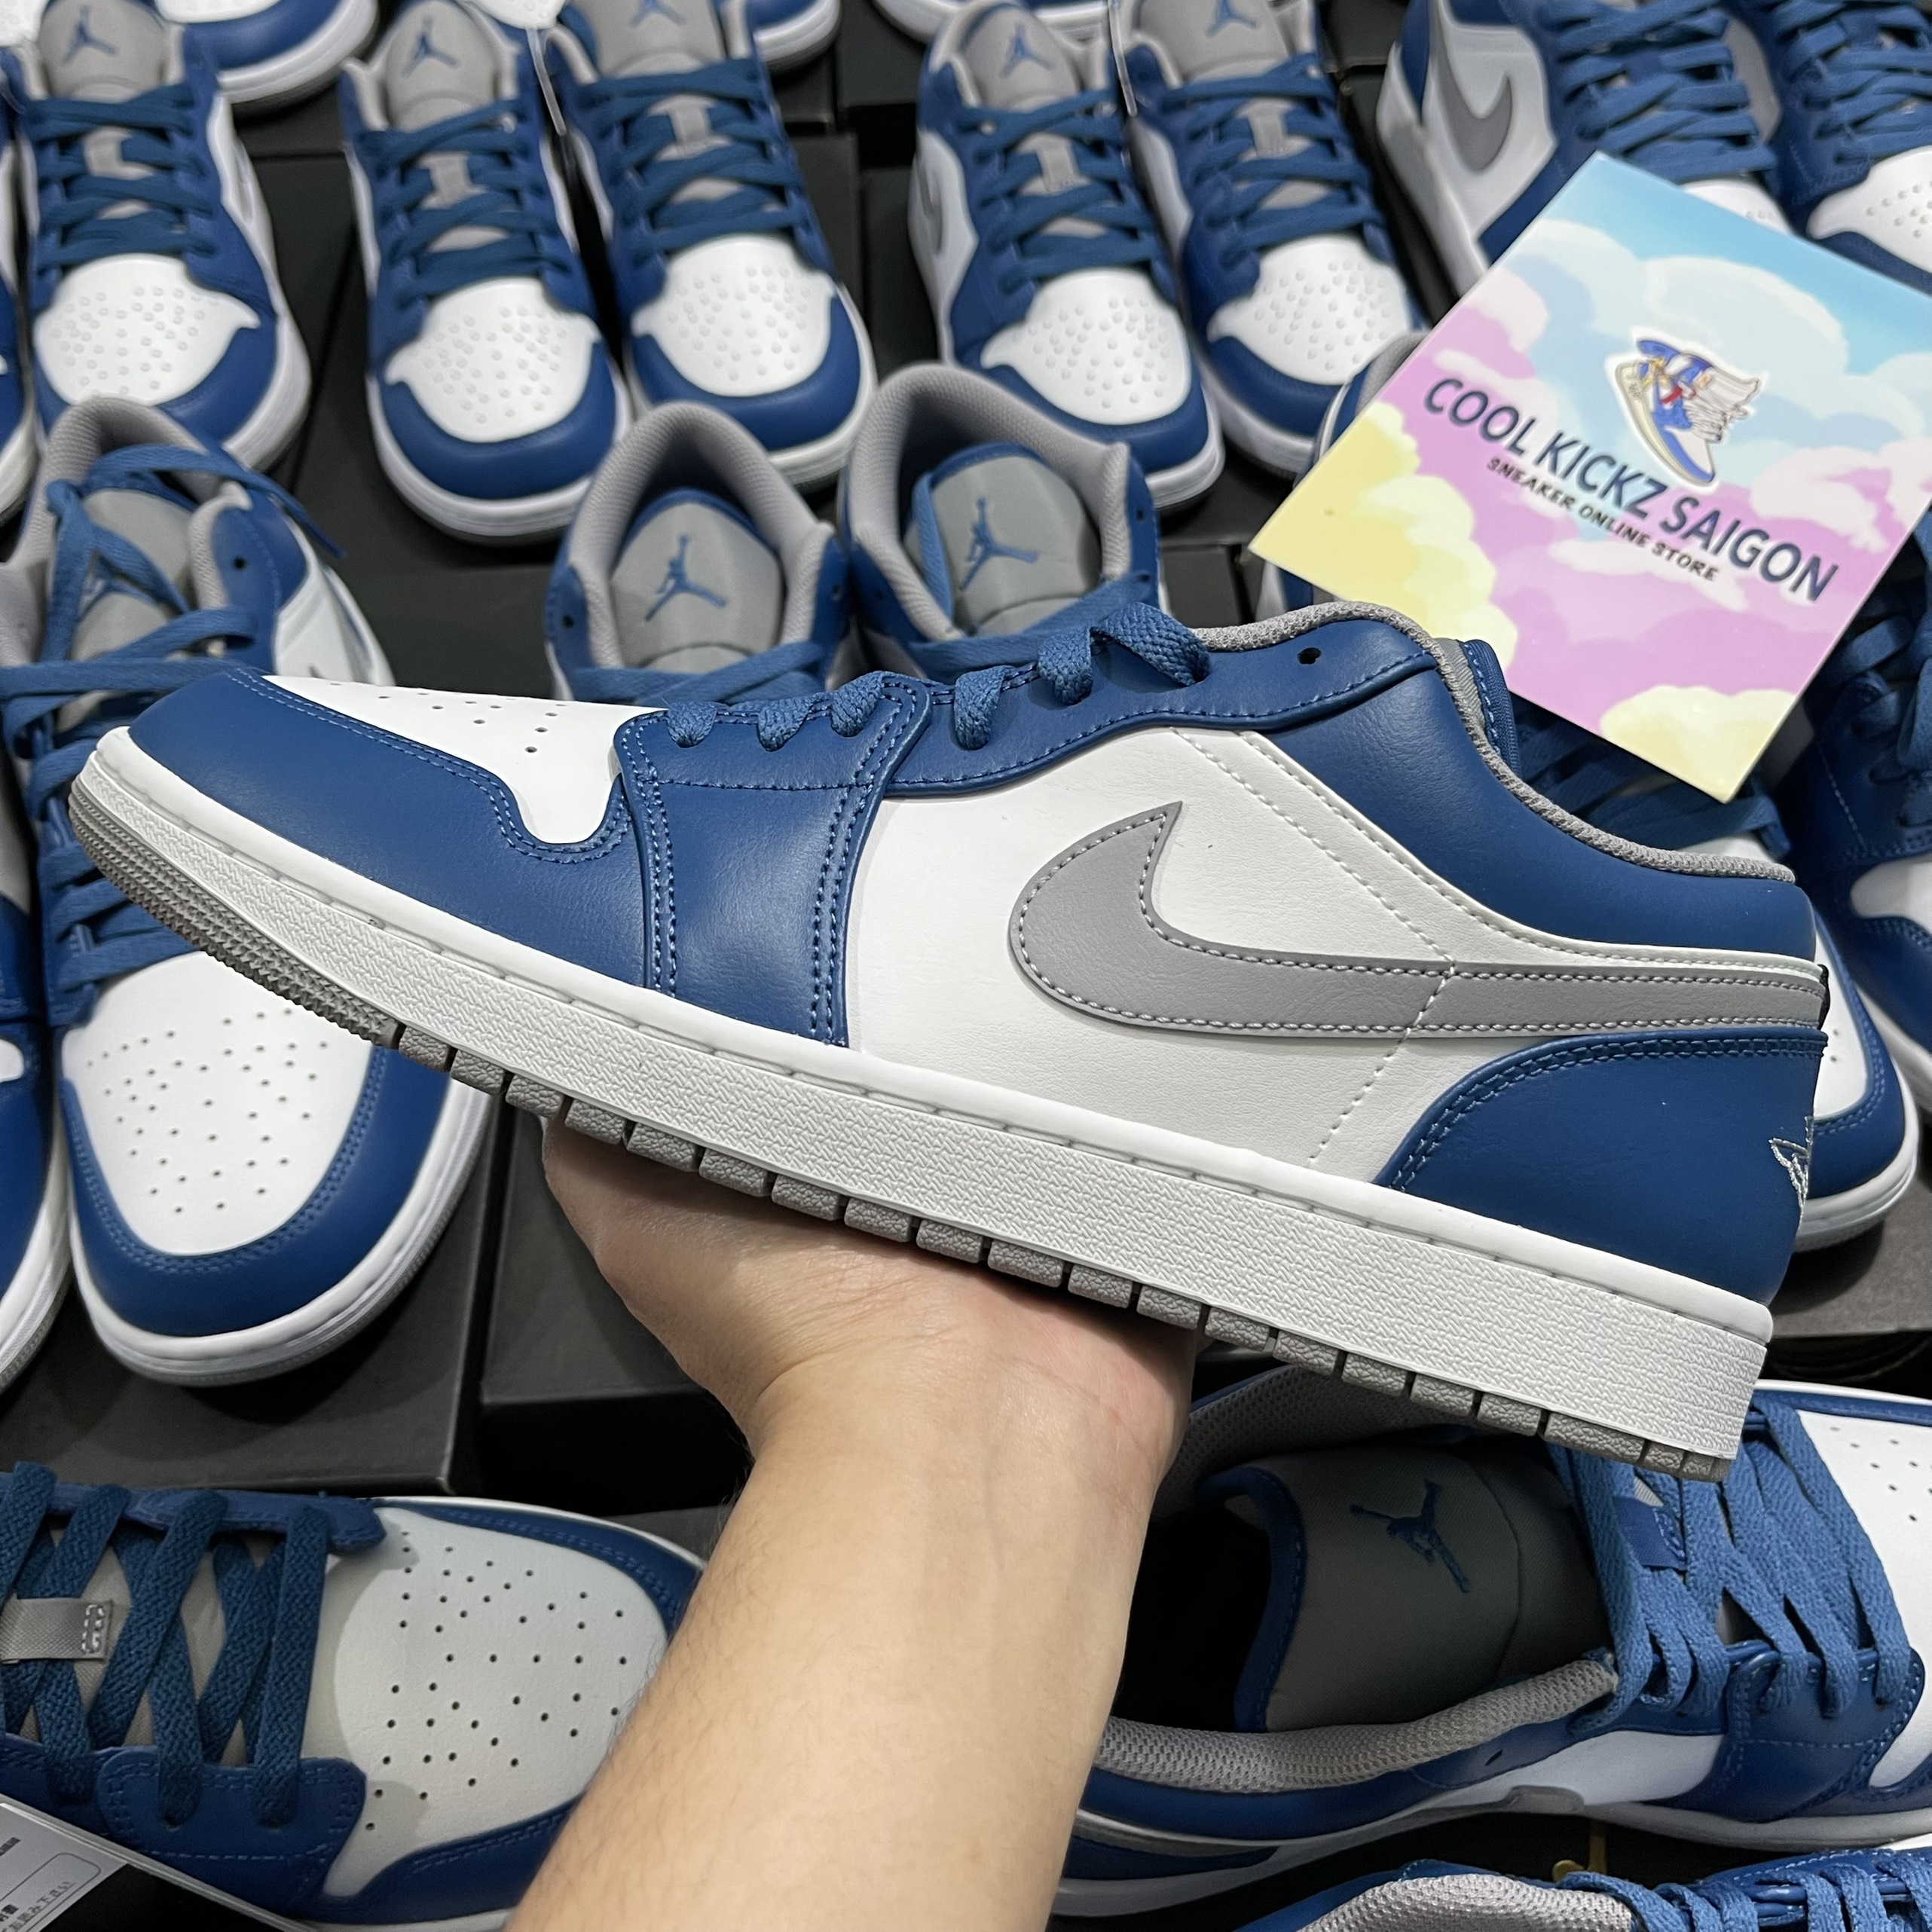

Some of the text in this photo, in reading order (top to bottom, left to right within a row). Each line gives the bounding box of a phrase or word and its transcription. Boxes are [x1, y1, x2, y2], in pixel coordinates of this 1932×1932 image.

[1424, 378, 1839, 601] COOL KICKZ SAIGON
[1487, 457, 1720, 582] SNEAKER ONLINE STORE
